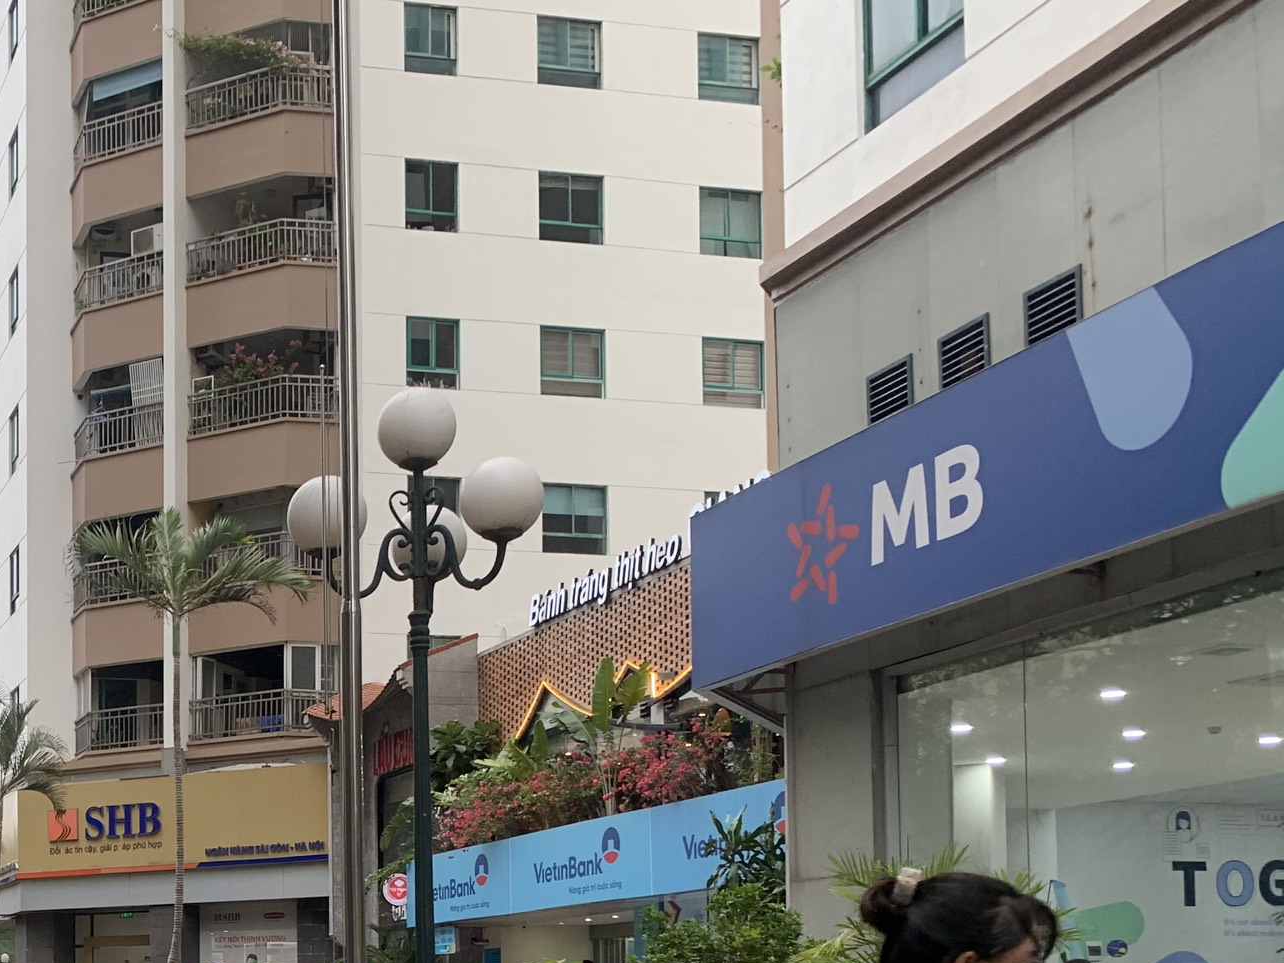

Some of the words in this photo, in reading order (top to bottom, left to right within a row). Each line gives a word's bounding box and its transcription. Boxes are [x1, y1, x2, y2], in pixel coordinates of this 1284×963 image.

[870, 444, 984, 566] MB
[529, 582, 567, 627] Bánh
[568, 568, 608, 605] tráng
[613, 545, 643, 589] thịt
[644, 535, 680, 572] heo
[85, 802, 162, 841] SHB
[533, 852, 603, 884] VietinBank
[432, 876, 476, 902] etinBank
[222, 912, 240, 921] SHB
[214, 934, 226, 943] KẾT
[227, 934, 239, 943] NỐI
[241, 934, 261, 943] THỊNH
